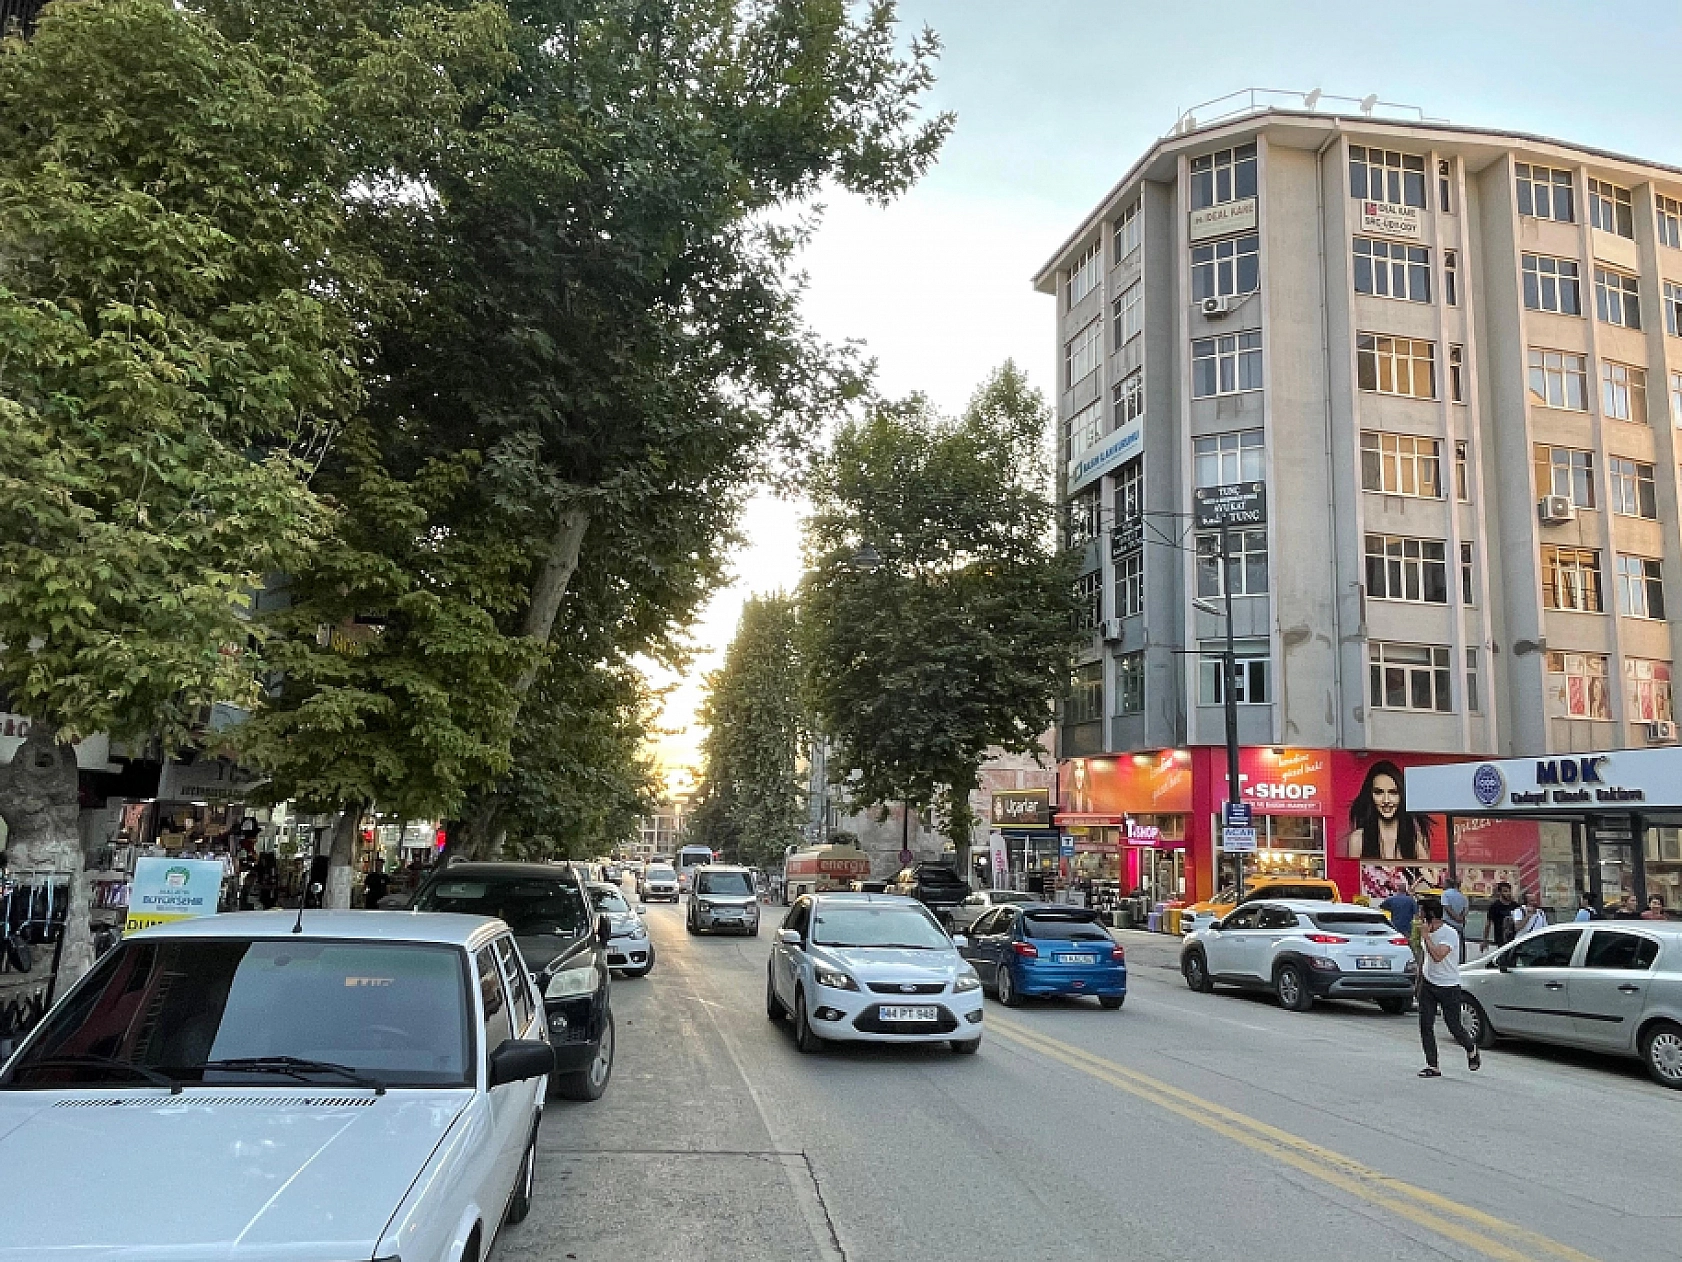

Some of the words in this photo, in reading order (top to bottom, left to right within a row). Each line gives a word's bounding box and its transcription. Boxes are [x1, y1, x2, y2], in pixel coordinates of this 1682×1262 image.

[1228, 509, 1260, 522] TUNÇ
[1536, 757, 1602, 785] MDK
[900, 1007, 913, 1018] PT
